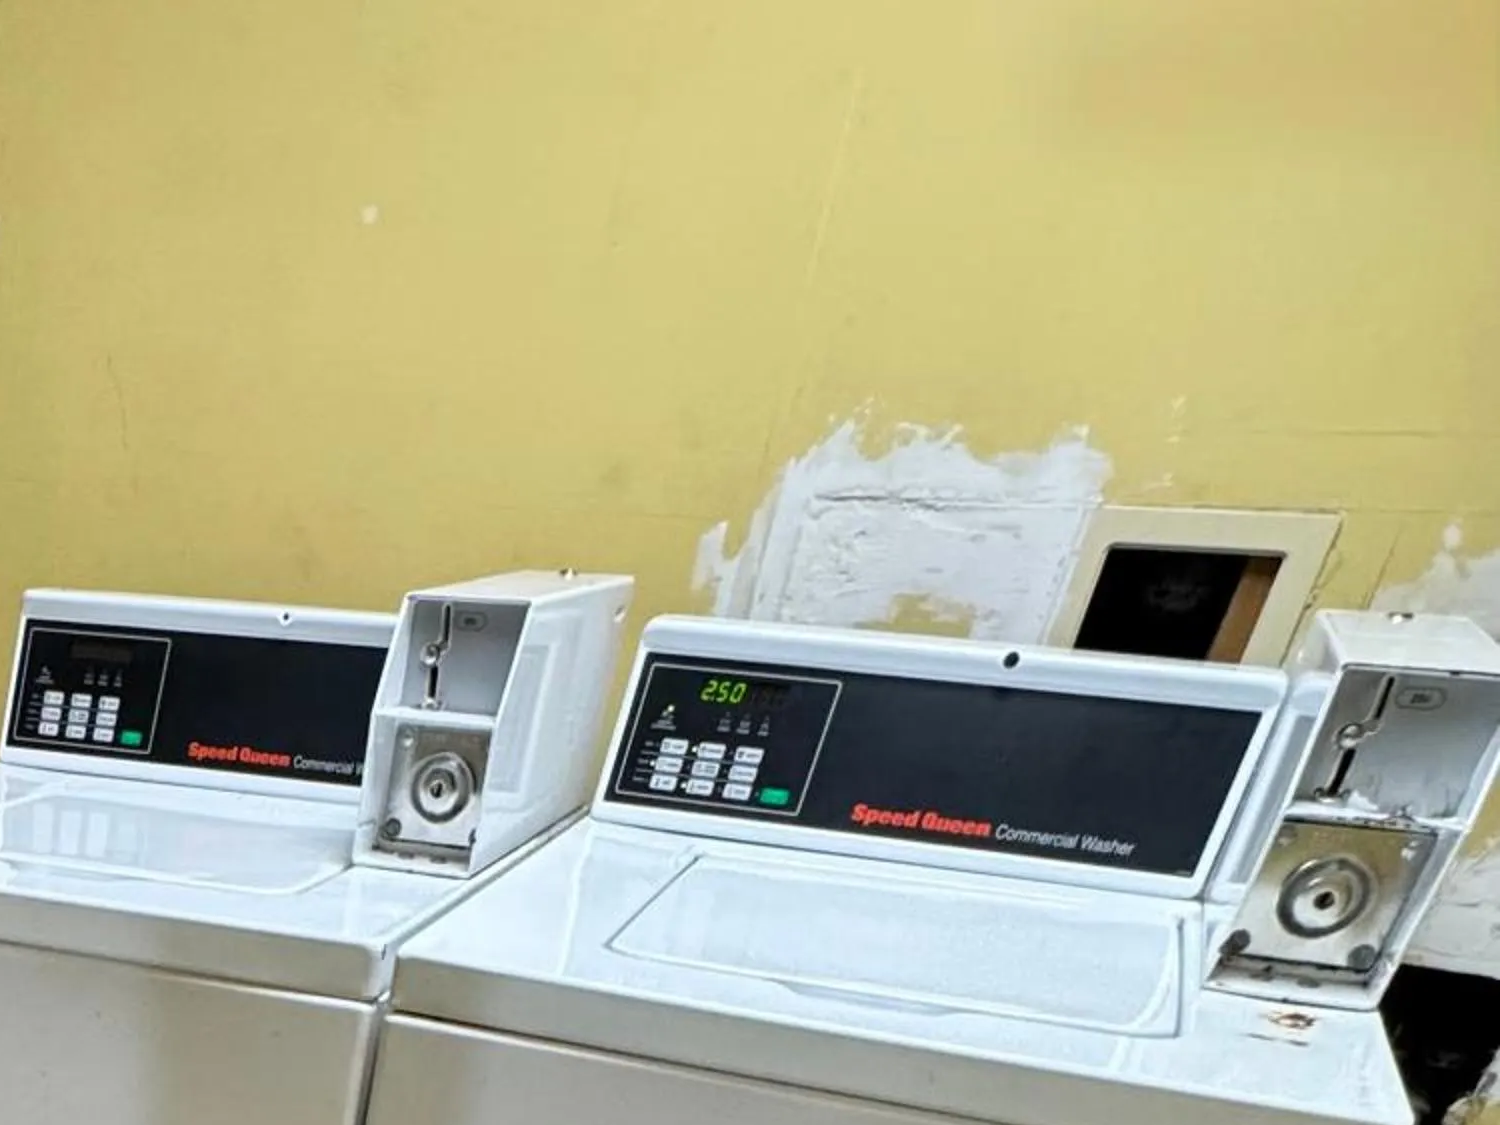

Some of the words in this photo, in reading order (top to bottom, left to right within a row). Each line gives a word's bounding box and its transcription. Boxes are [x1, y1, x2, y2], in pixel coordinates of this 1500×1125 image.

[188, 742, 238, 761] Speed
[240, 747, 291, 767] Queen
[293, 754, 355, 775] Commercial
[851, 803, 921, 828] Speed
[921, 811, 991, 836] Queen
[995, 823, 1080, 849] Commercial
[1080, 834, 1137, 856] Washer
